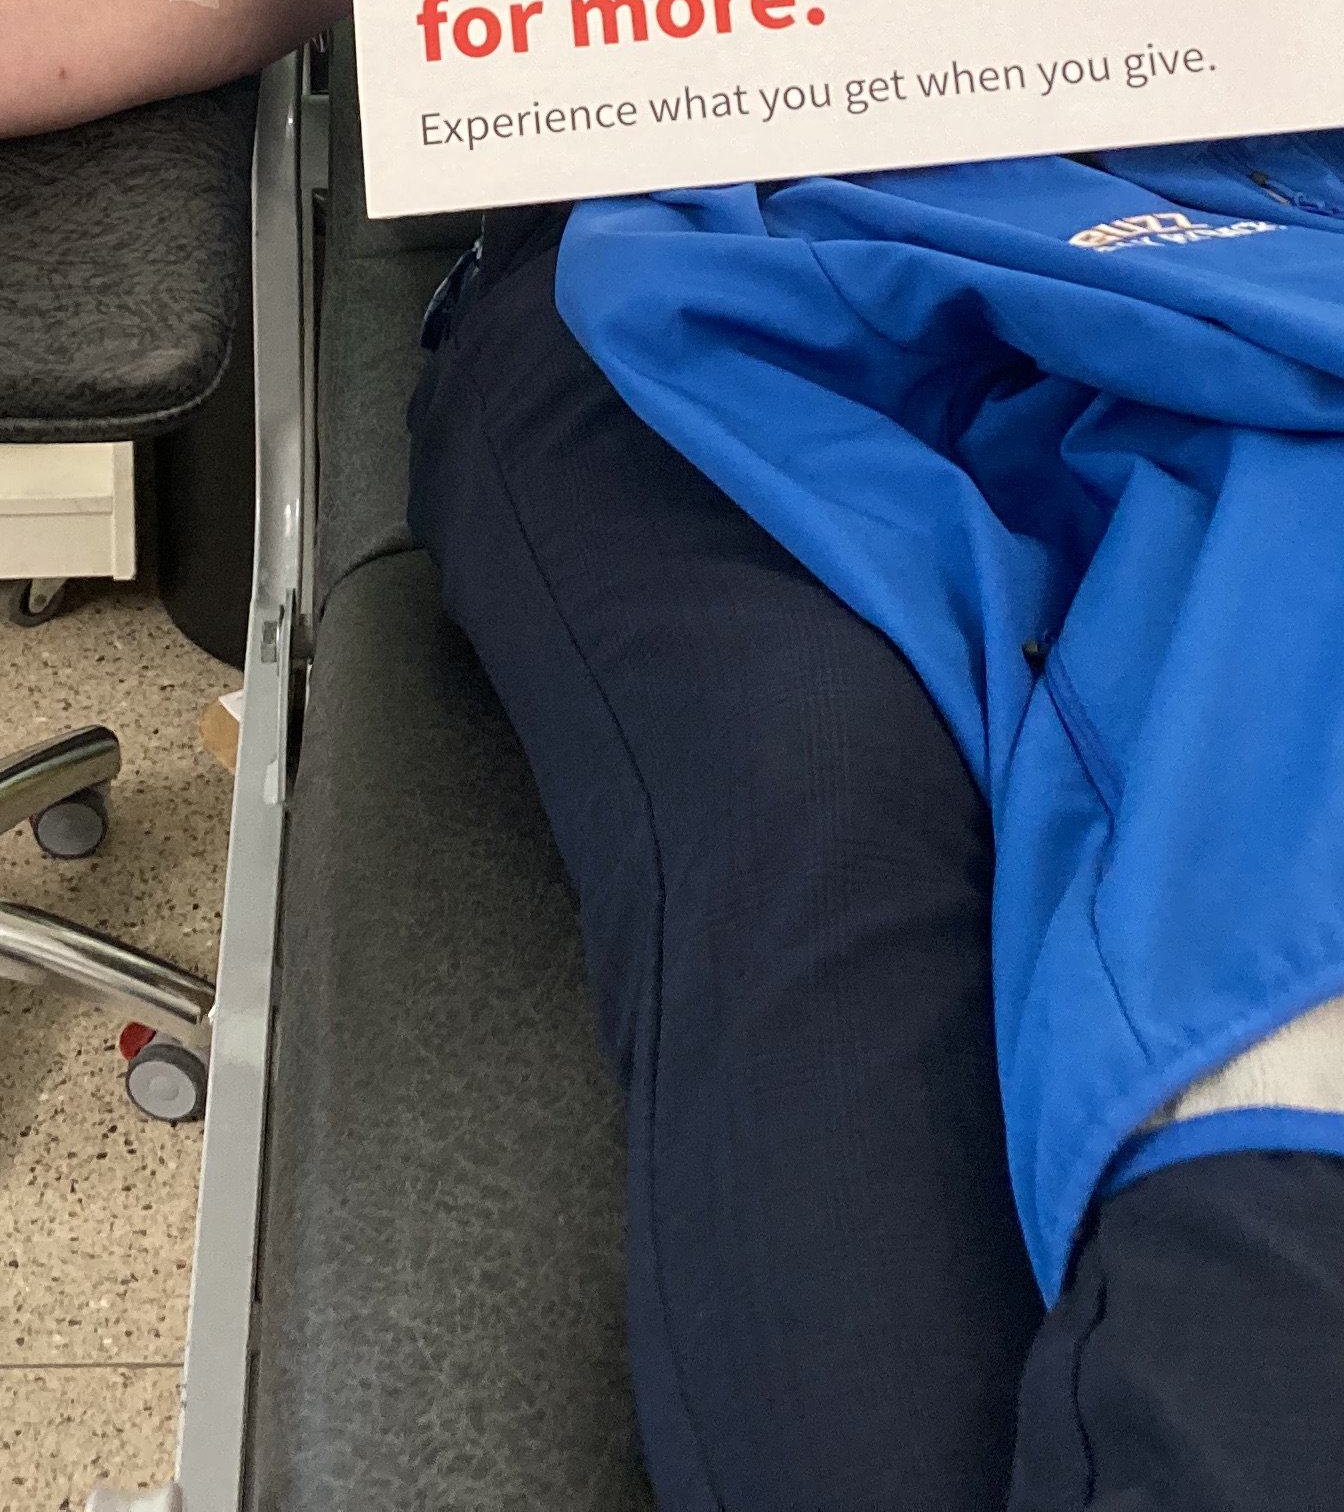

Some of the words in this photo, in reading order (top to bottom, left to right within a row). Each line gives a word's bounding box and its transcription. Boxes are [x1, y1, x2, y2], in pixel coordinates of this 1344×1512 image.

[421, 100, 637, 152] Experience
[649, 85, 750, 123] what
[759, 83, 832, 123] you
[846, 72, 906, 114] get
[918, 62, 1024, 96] when
[1038, 58, 1109, 95] you
[1124, 43, 1218, 88] give.
